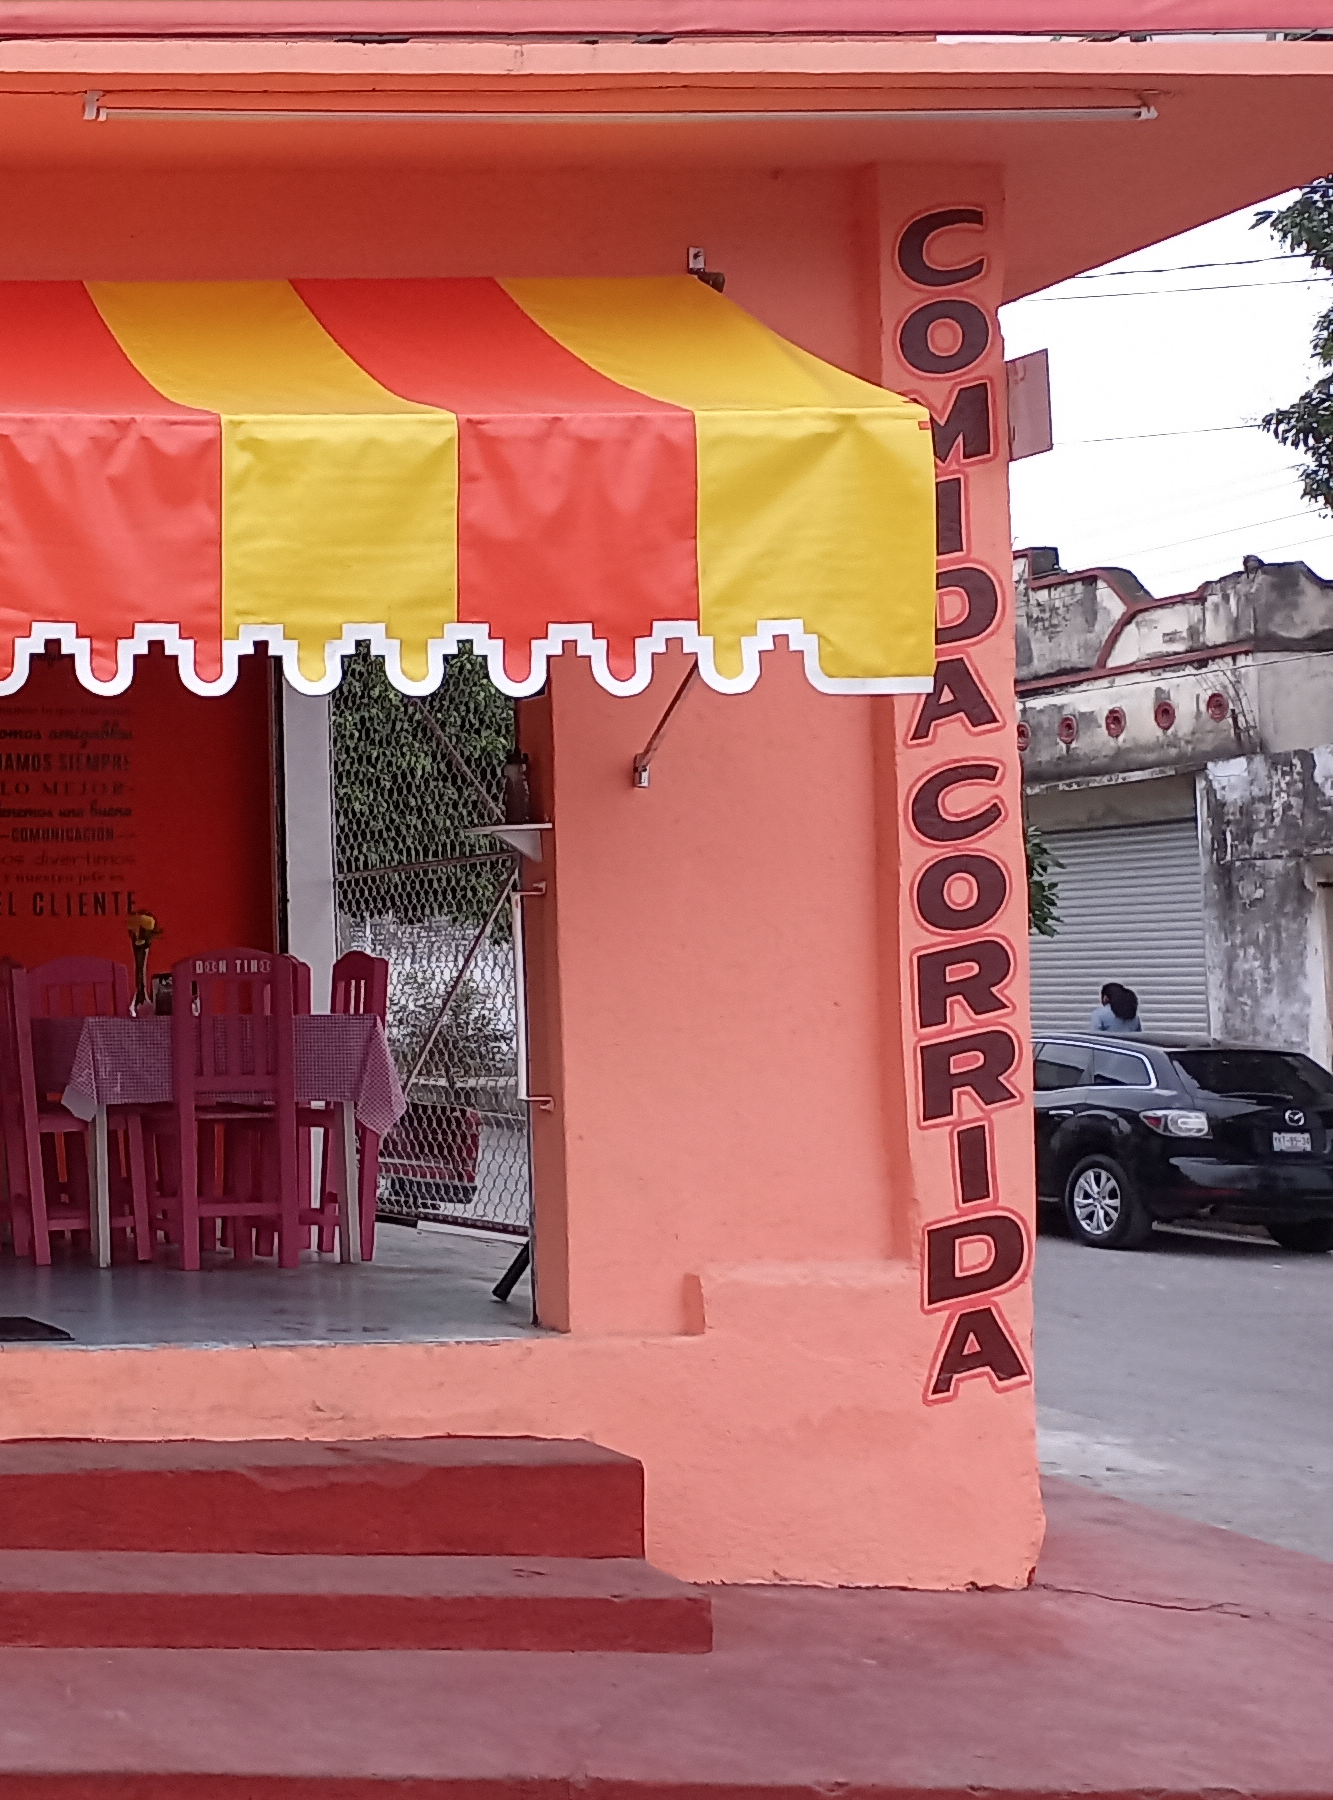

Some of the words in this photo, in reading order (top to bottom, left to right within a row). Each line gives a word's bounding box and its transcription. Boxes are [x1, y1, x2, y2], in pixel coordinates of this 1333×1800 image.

[895, 205, 1003, 744] COMIDA
[32, 890, 137, 917] CLIENTE
[194, 959, 227, 975] DON
[234, 958, 272, 975] TINO
[909, 760, 1031, 1398] CORRIDA
